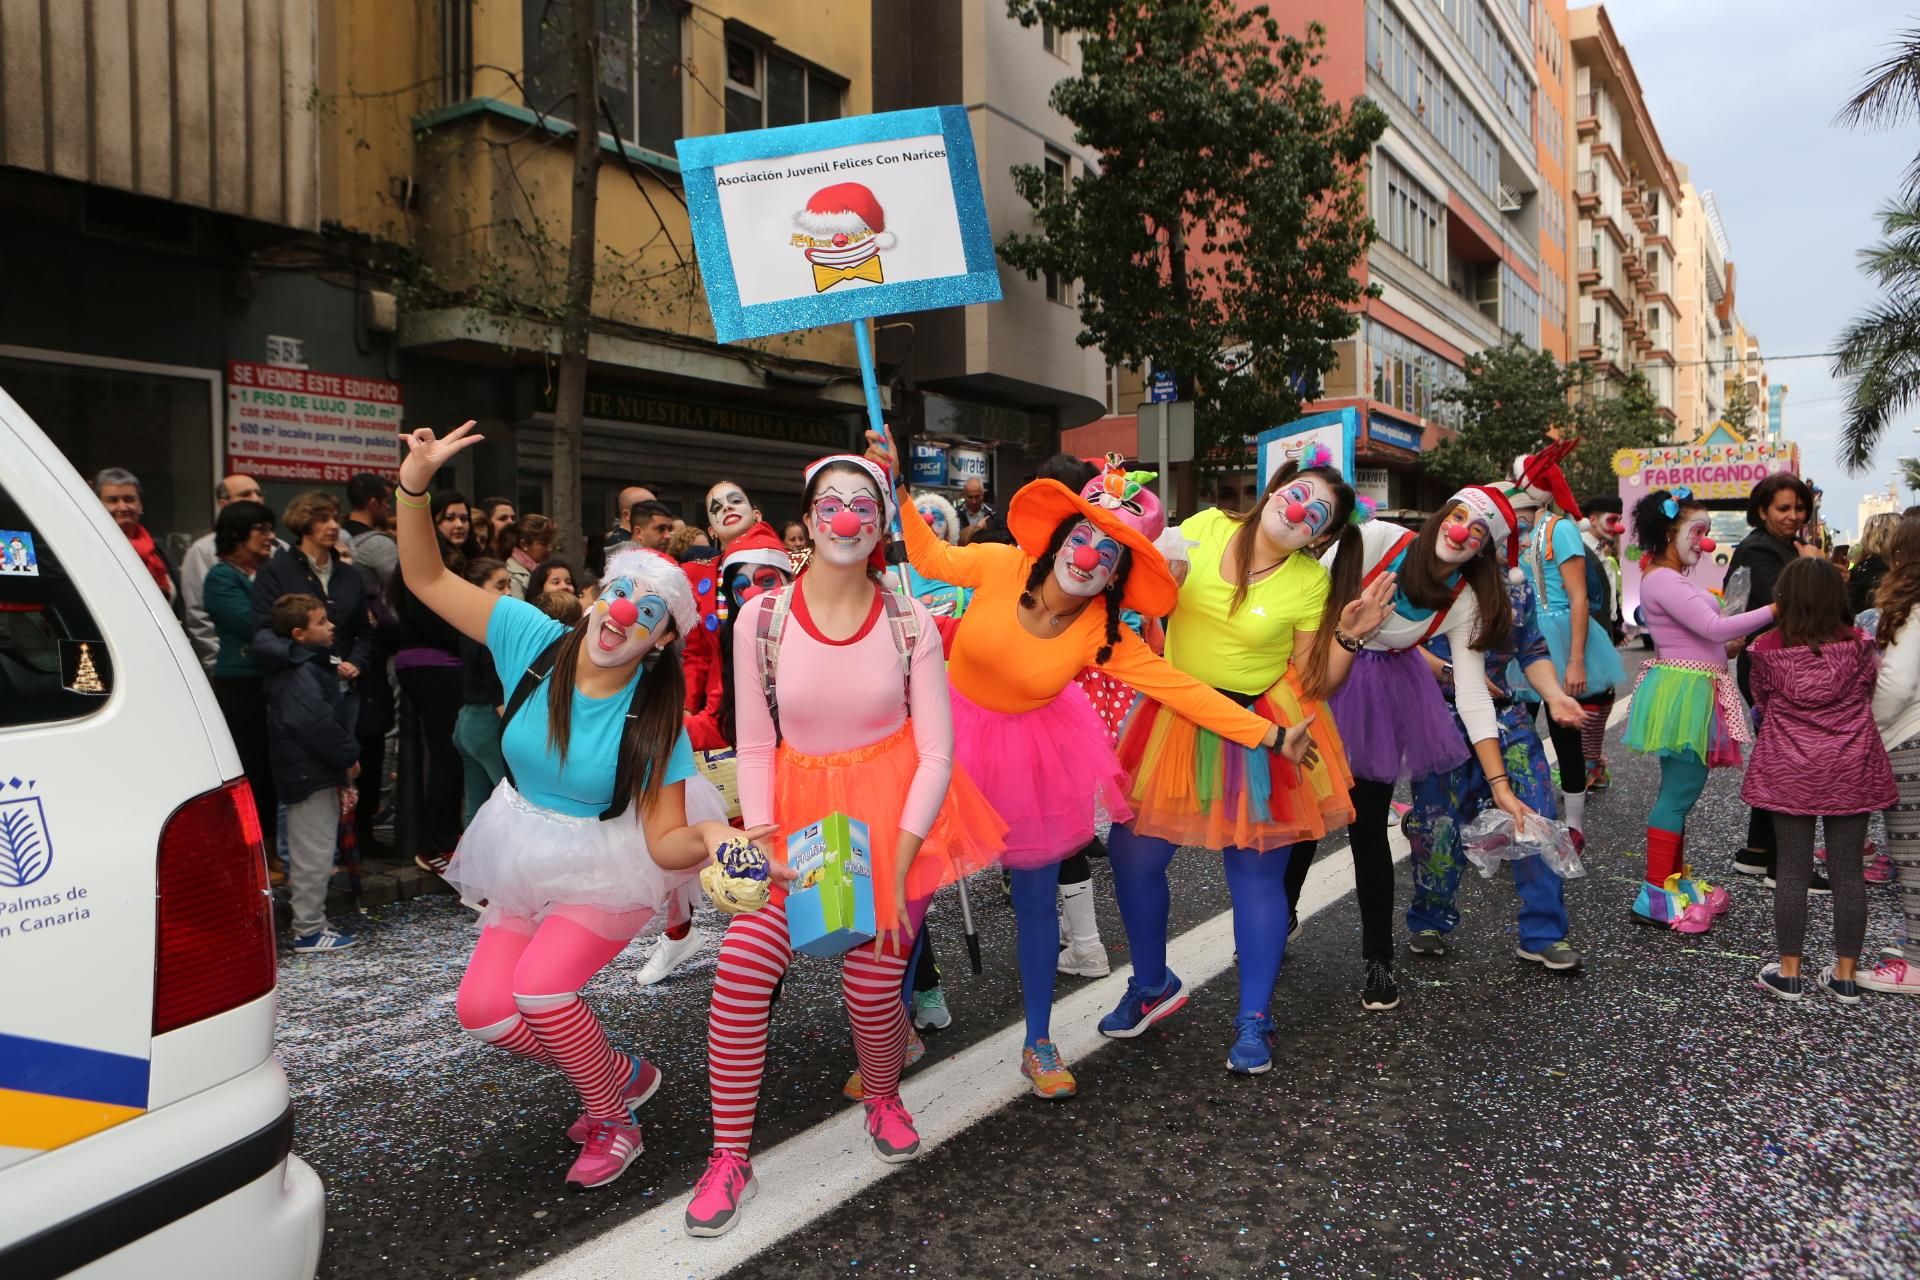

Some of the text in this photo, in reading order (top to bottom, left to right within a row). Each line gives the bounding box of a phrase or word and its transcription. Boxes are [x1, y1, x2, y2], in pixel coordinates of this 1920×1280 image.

[717, 147, 947, 187] Asociación Juvenil Felices Con Narices
[233, 364, 398, 402] SE VENDE ESTE EDIFICIO
[241, 389, 248, 402] 1
[252, 390, 286, 407] PISO
[290, 394, 308, 410] DE
[311, 397, 346, 414] LUJO
[353, 402, 376, 417] 200
[616, 396, 705, 428] NUESTRA
[708, 408, 786, 439] PRIMERA
[789, 420, 846, 446] PLANTA
[323, 464, 349, 482] 675
[1645, 464, 1768, 486] FABRICANDO
[796, 839, 827, 871] Frutas
[66, 885, 88, 901] de
[20, 907, 90, 933] Canaria
